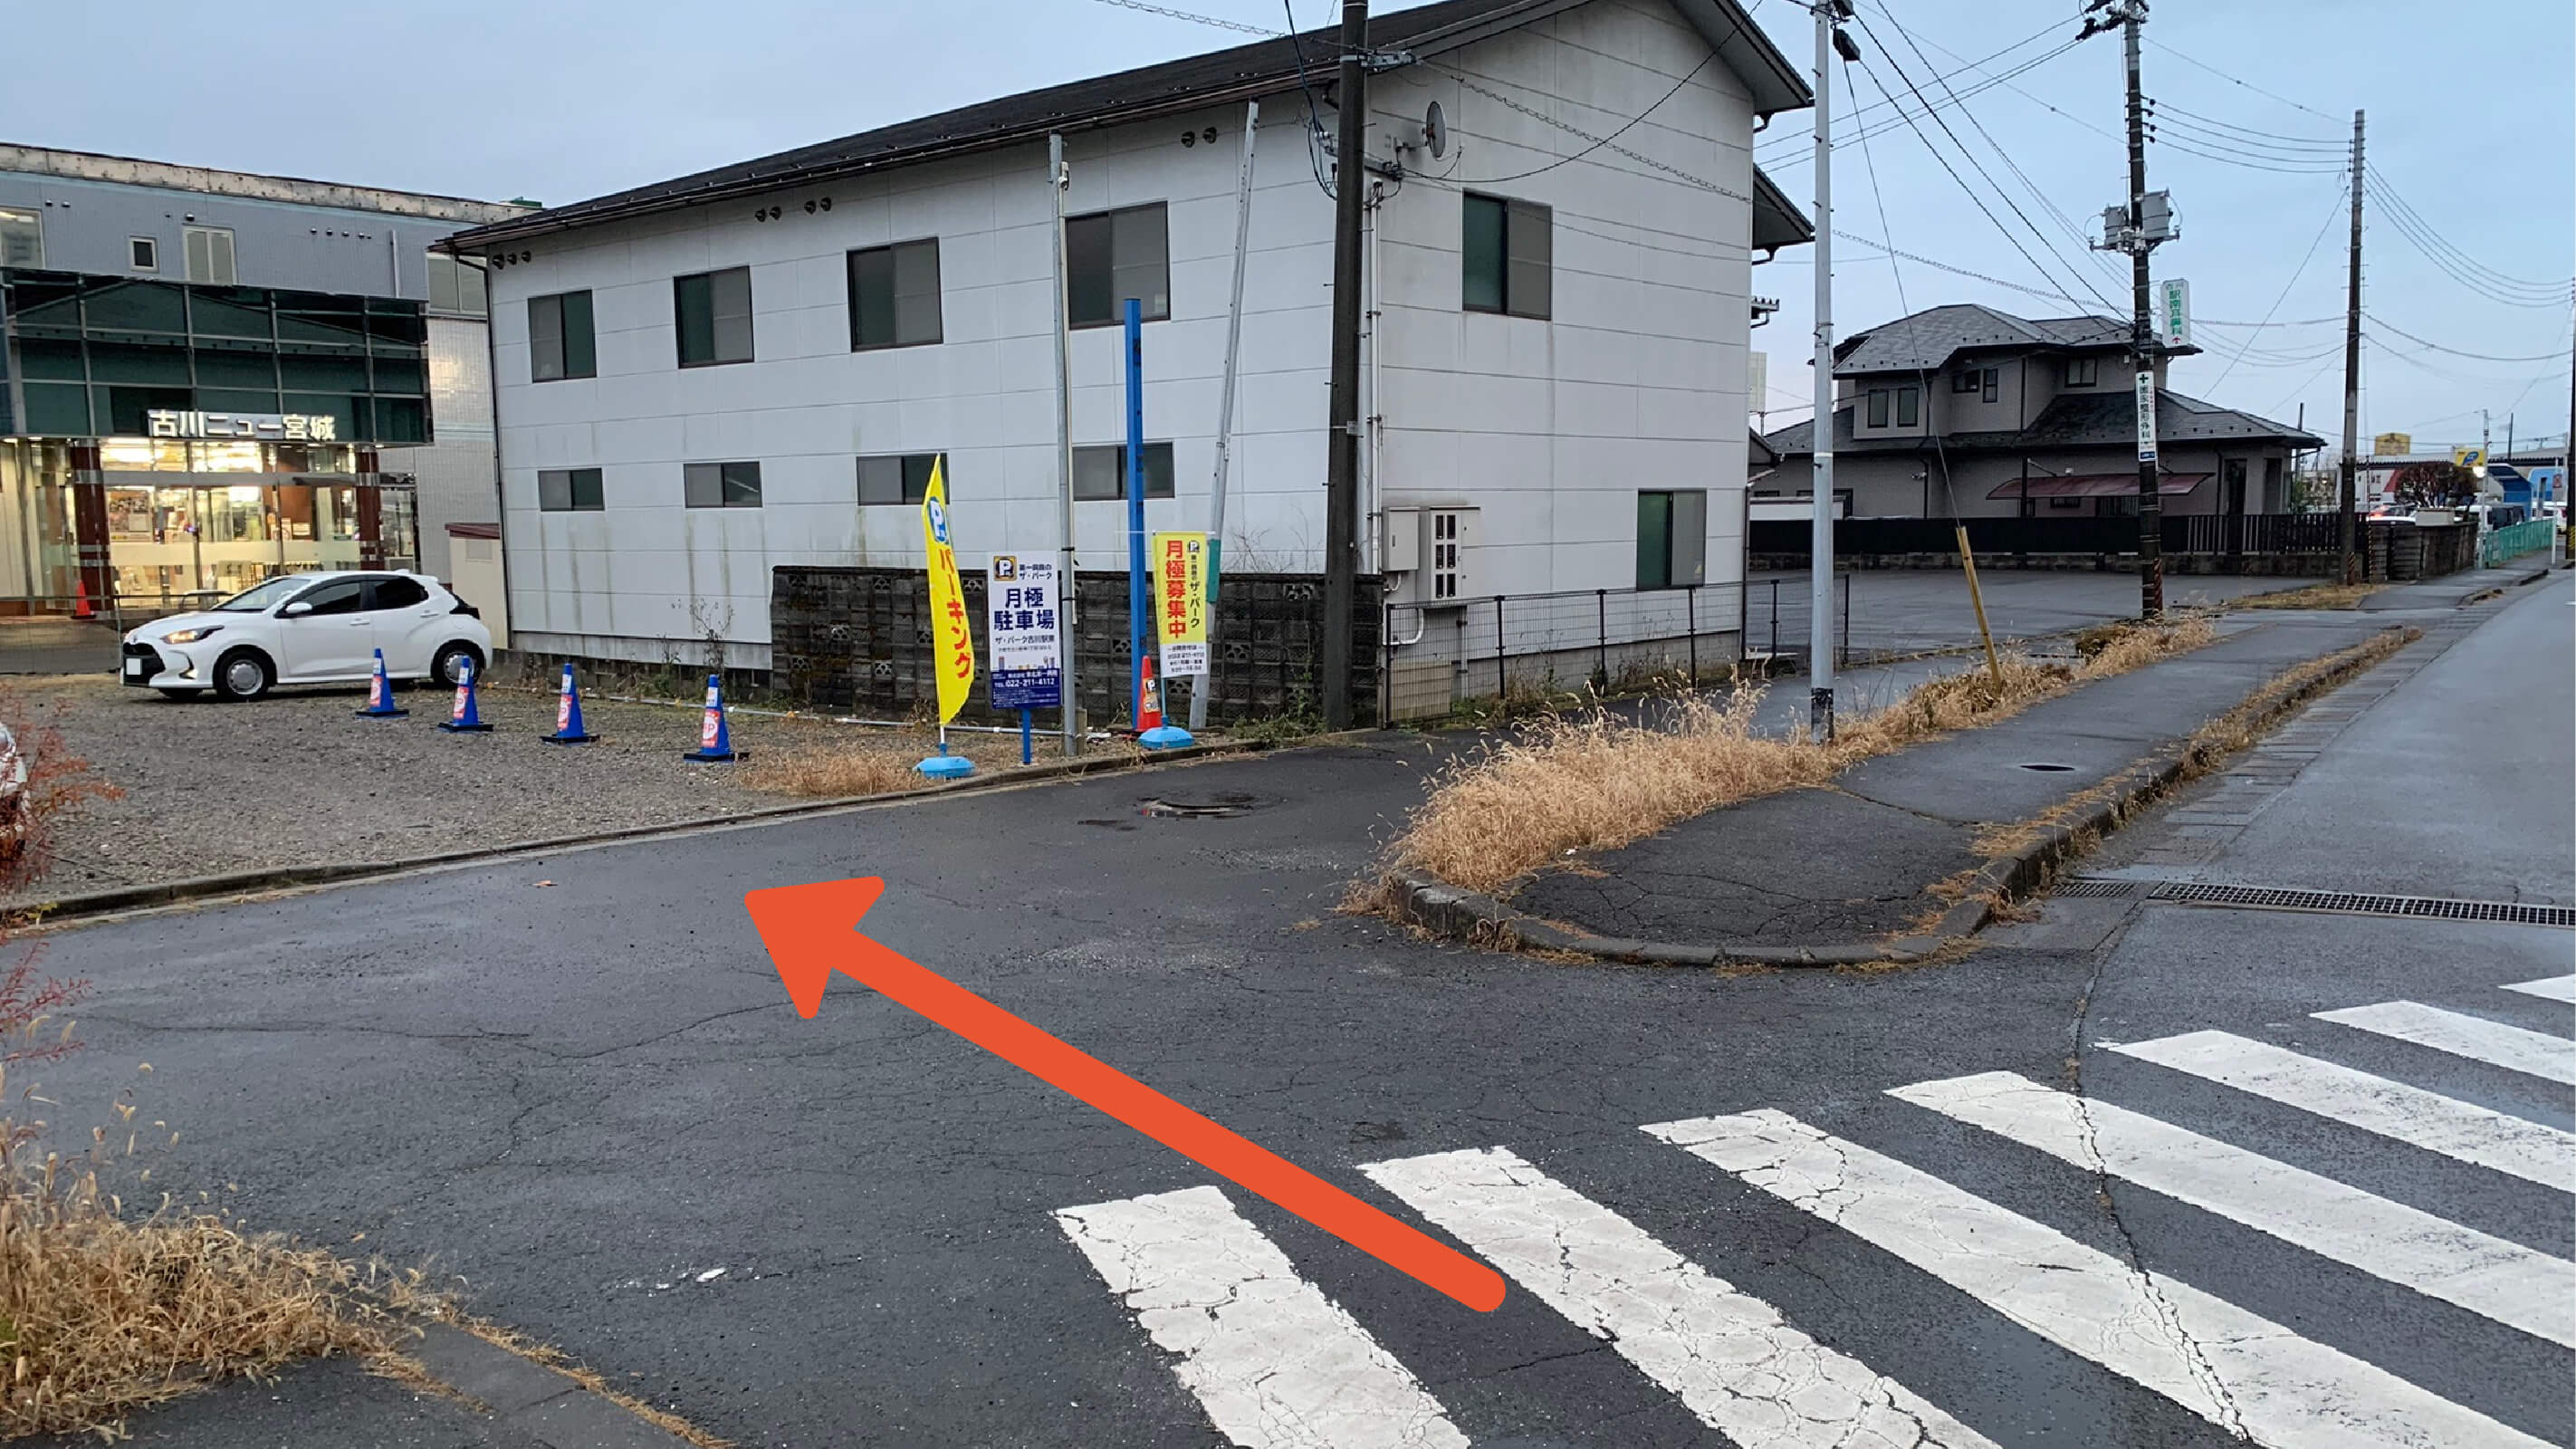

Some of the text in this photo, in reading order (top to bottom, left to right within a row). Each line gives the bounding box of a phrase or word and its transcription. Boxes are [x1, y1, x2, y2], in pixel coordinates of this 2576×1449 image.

[149, 409, 336, 440] 古川ニュー宮城
[1019, 571, 1052, 580] ザ・パーク
[1006, 587, 1043, 609] 月極
[1166, 540, 1187, 638] 月極募集中
[939, 549, 972, 678] パーキング
[994, 609, 1054, 630] 駐車場
